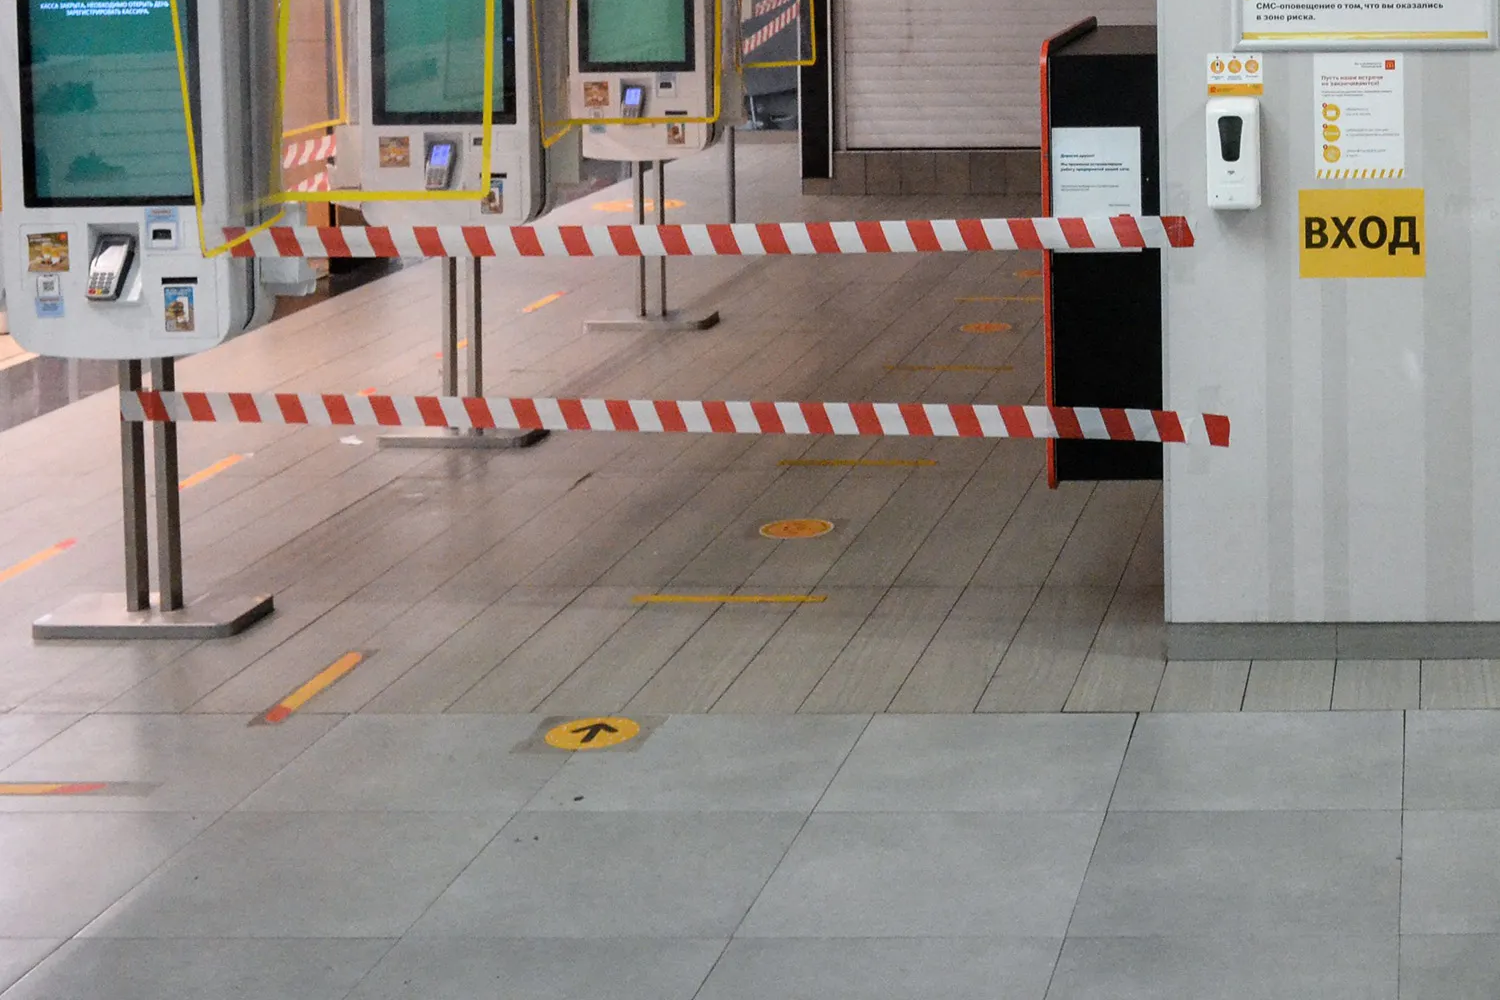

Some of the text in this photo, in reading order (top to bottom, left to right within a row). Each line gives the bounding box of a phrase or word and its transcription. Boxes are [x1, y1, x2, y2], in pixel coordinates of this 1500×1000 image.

[1255, 2, 1336, 11] СМС-оповещение
[1395, 2, 1444, 10] оказались
[1286, 14, 1316, 23] риска.
[1304, 215, 1420, 256] ВХОД
